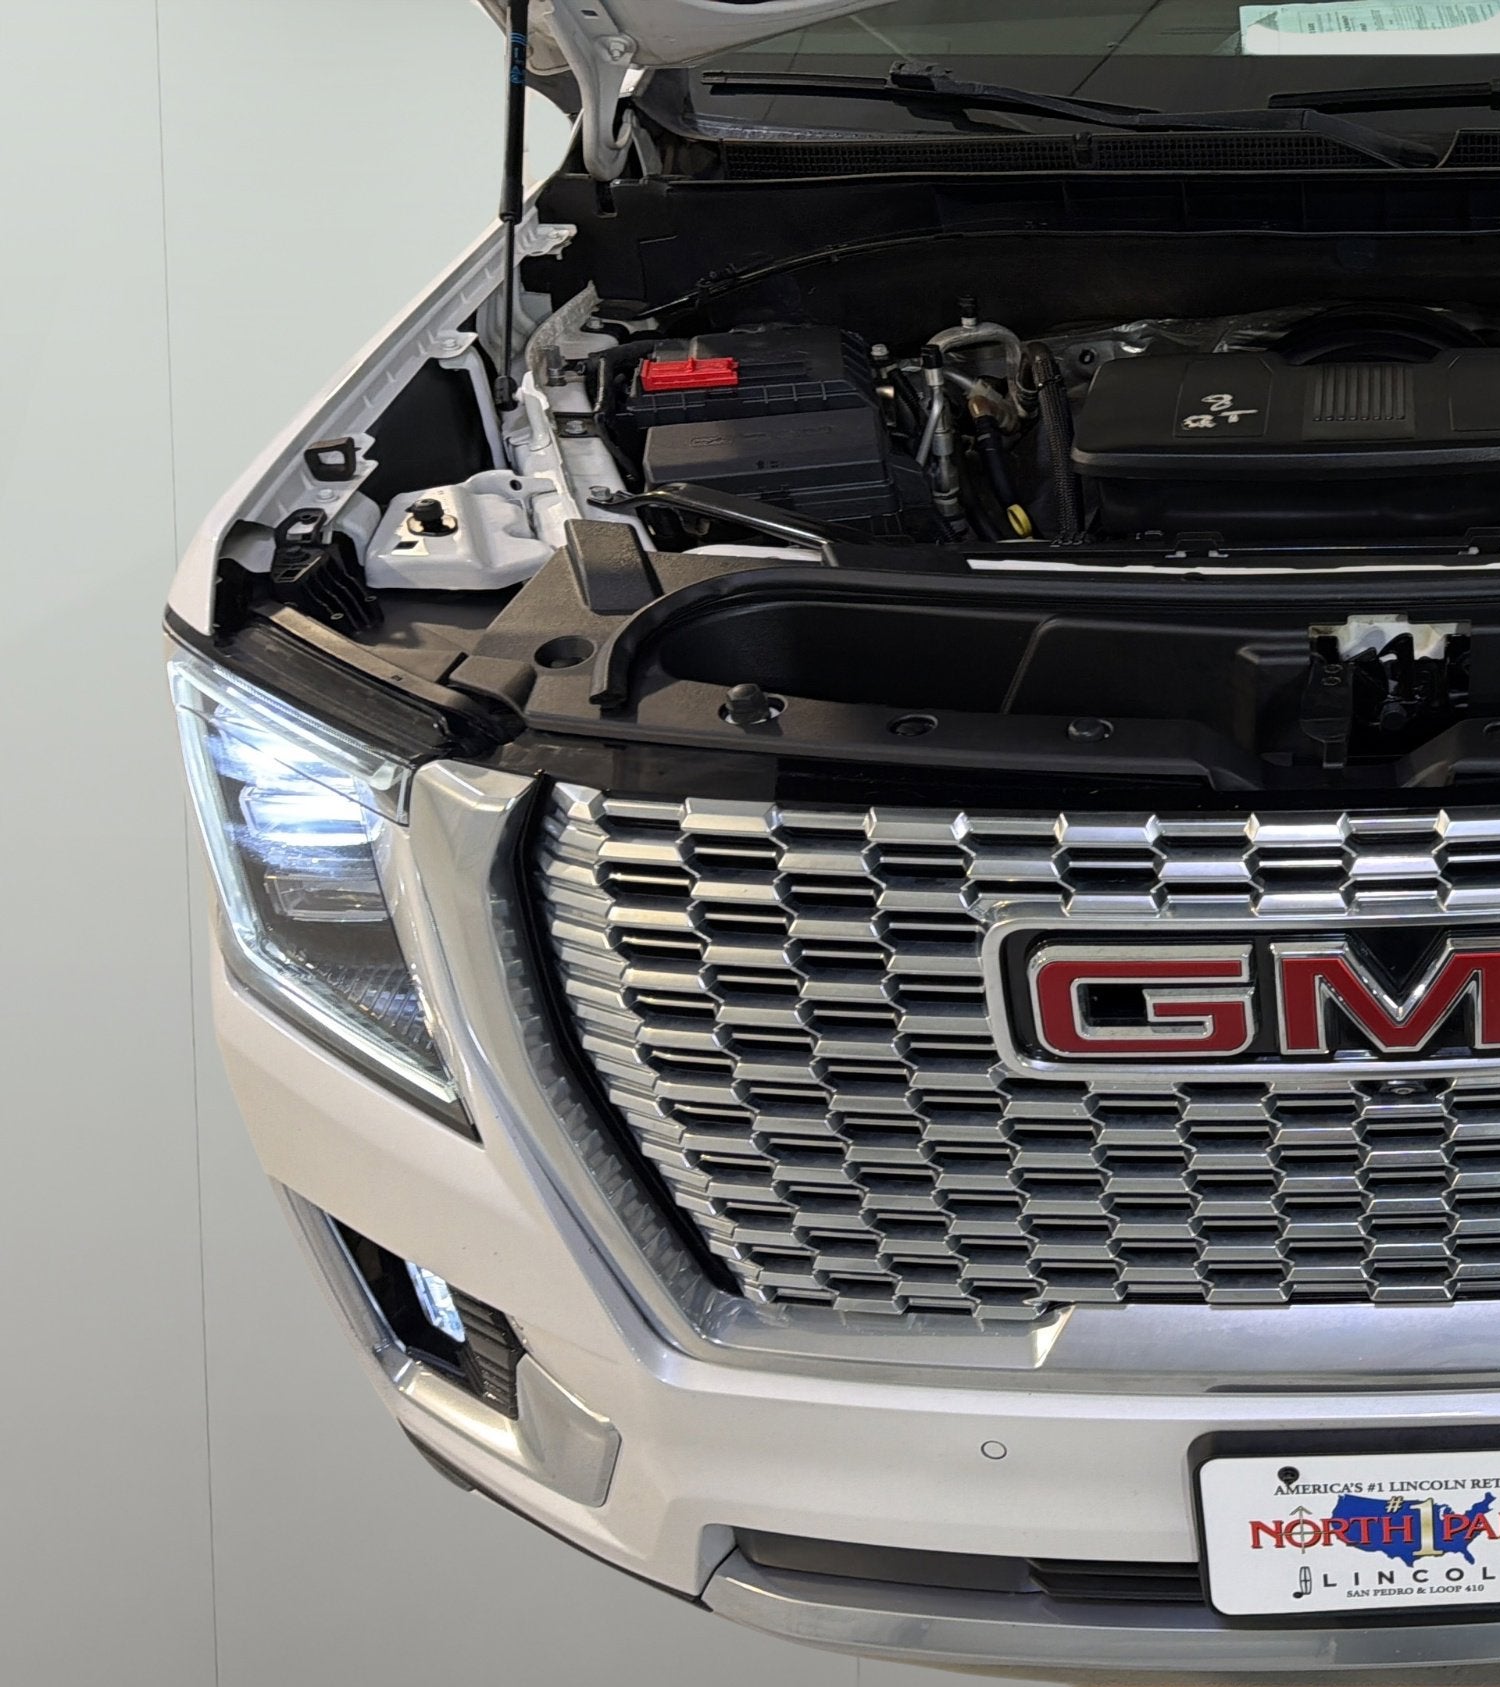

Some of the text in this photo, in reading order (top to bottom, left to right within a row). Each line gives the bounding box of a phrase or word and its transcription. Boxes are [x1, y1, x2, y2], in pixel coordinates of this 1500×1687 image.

[1274, 1482, 1363, 1496] AMERICA'S
[1367, 1482, 1385, 1493] #1
[1389, 1480, 1466, 1493] LINCOLN
[1249, 1514, 1415, 1549] NORTH
[1346, 1583, 1485, 1599] SAN PEDRO & LOOP 410
